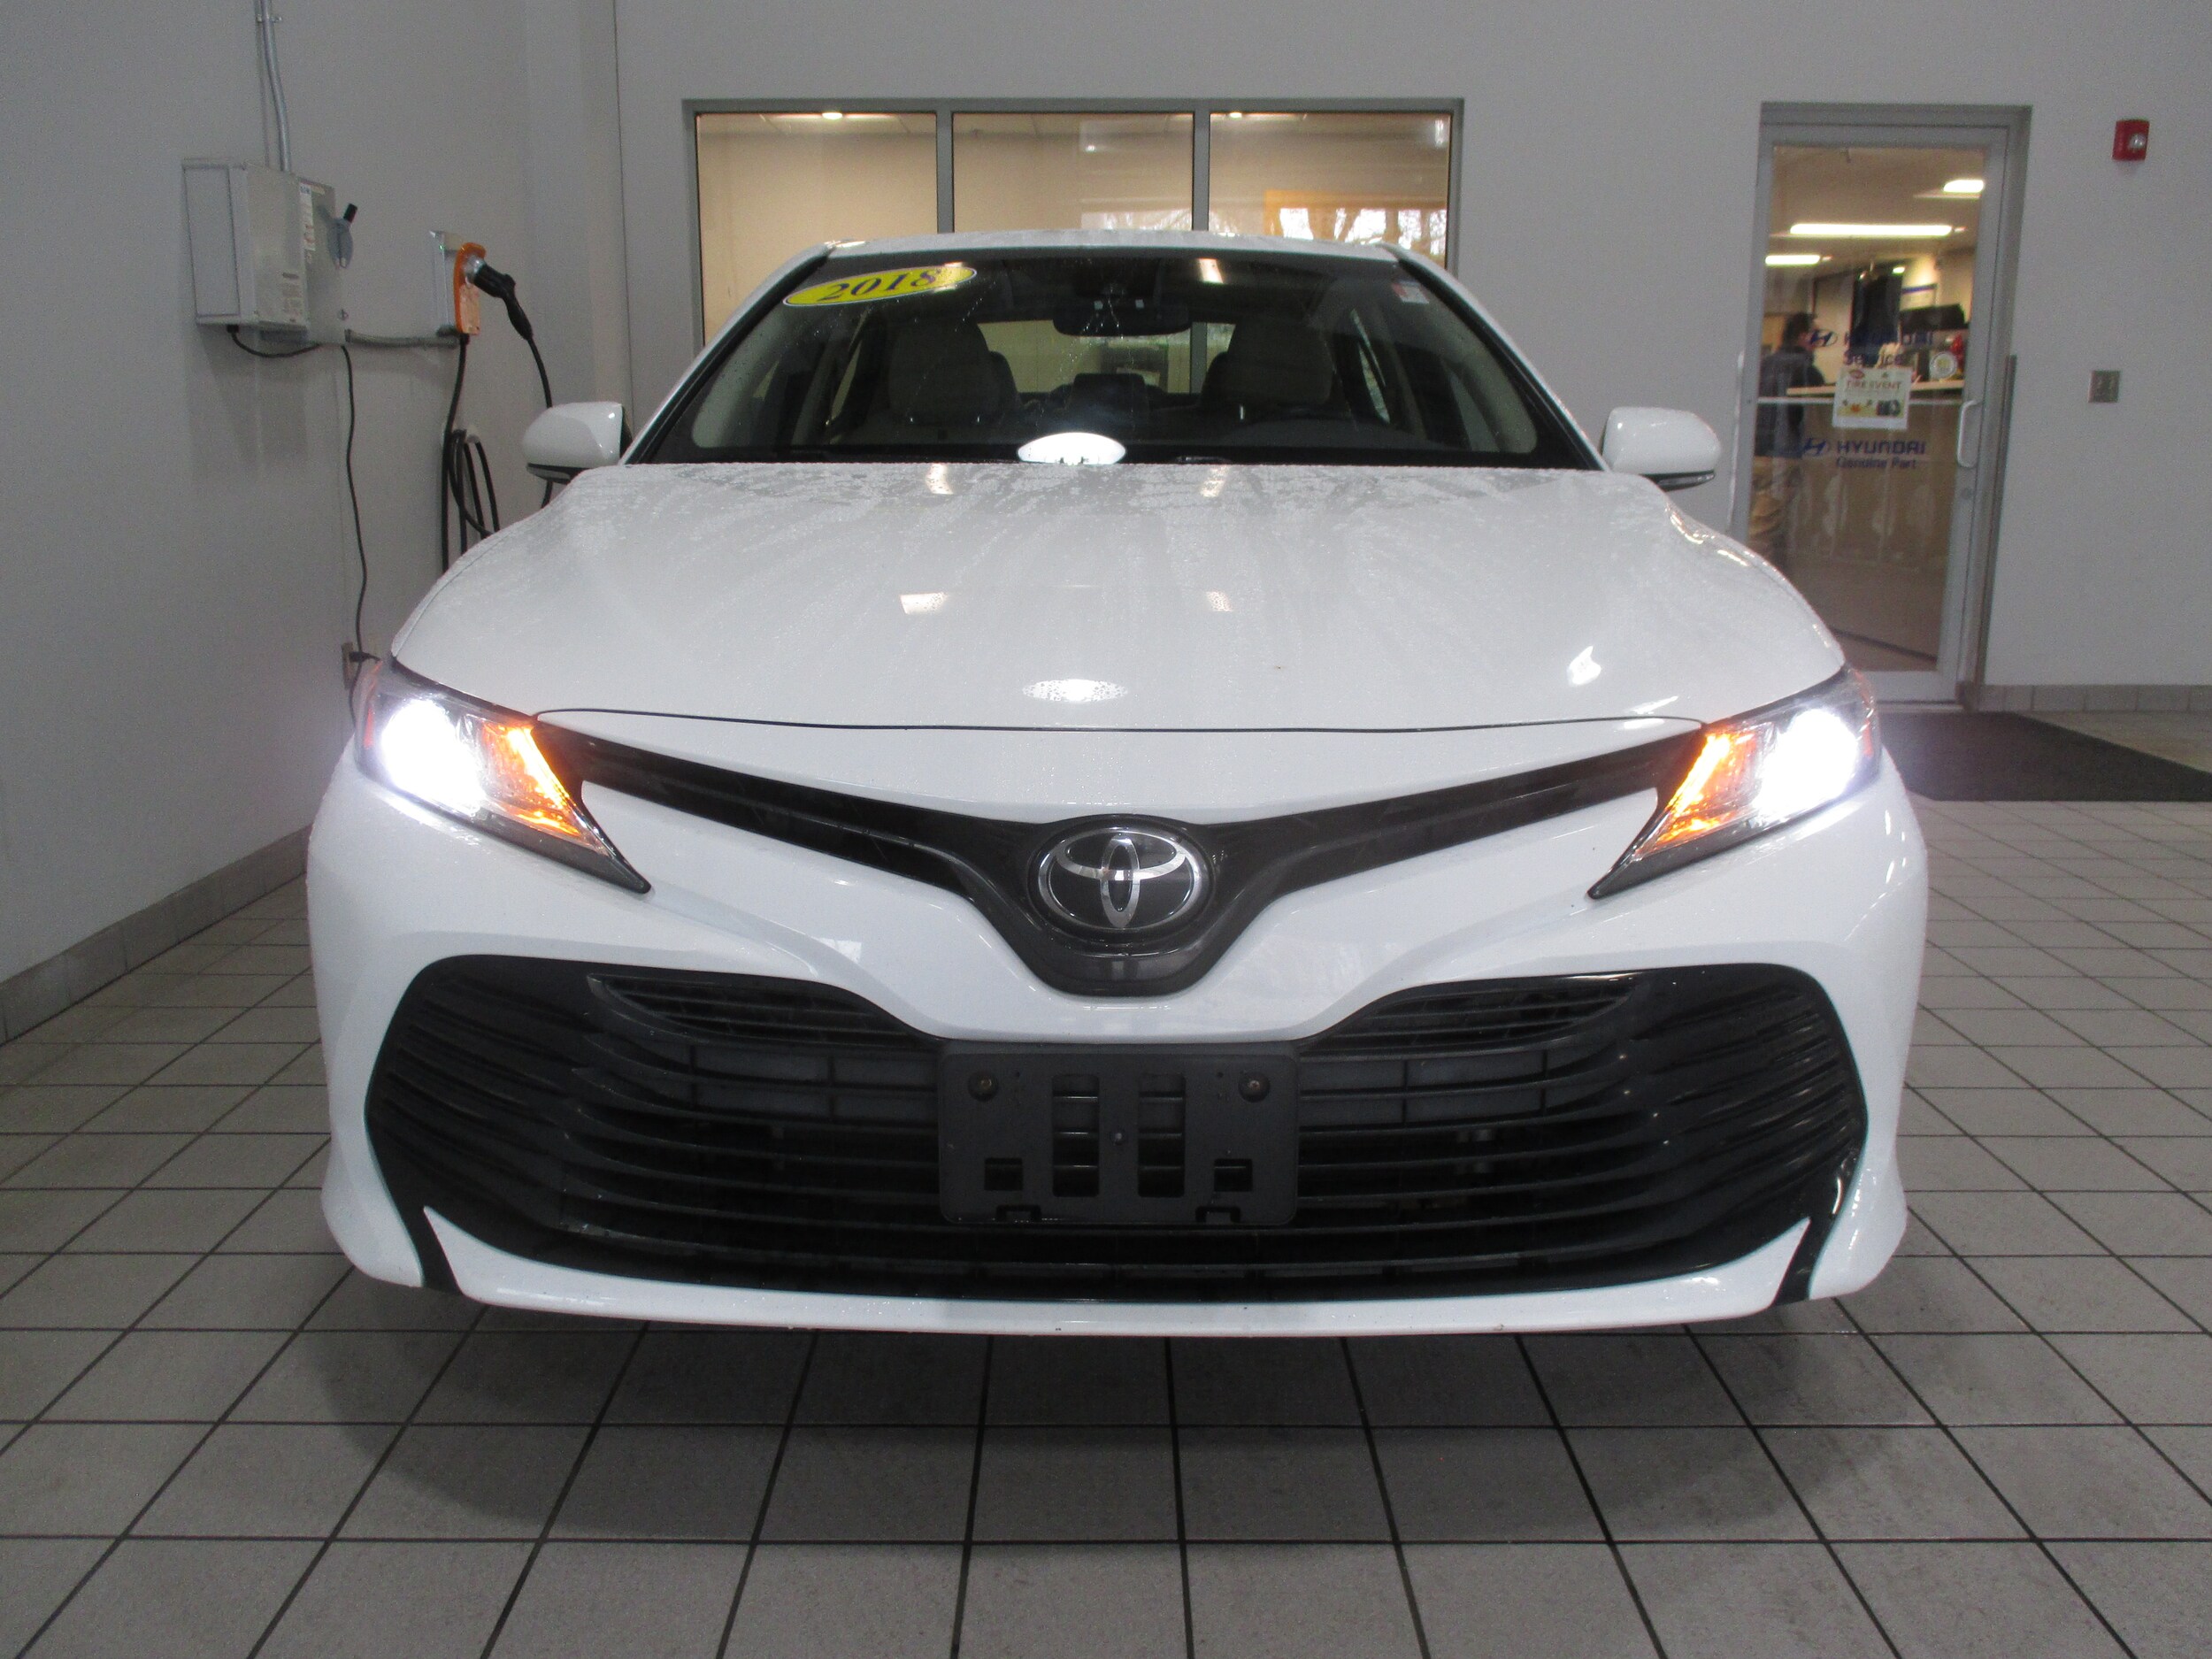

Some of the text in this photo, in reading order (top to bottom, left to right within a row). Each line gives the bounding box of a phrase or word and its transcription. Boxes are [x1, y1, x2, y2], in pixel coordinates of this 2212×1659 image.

[817, 268, 941, 302] 2018
[1837, 440, 1926, 455] HYUNDAI
[1836, 456, 1888, 469] Genuine
